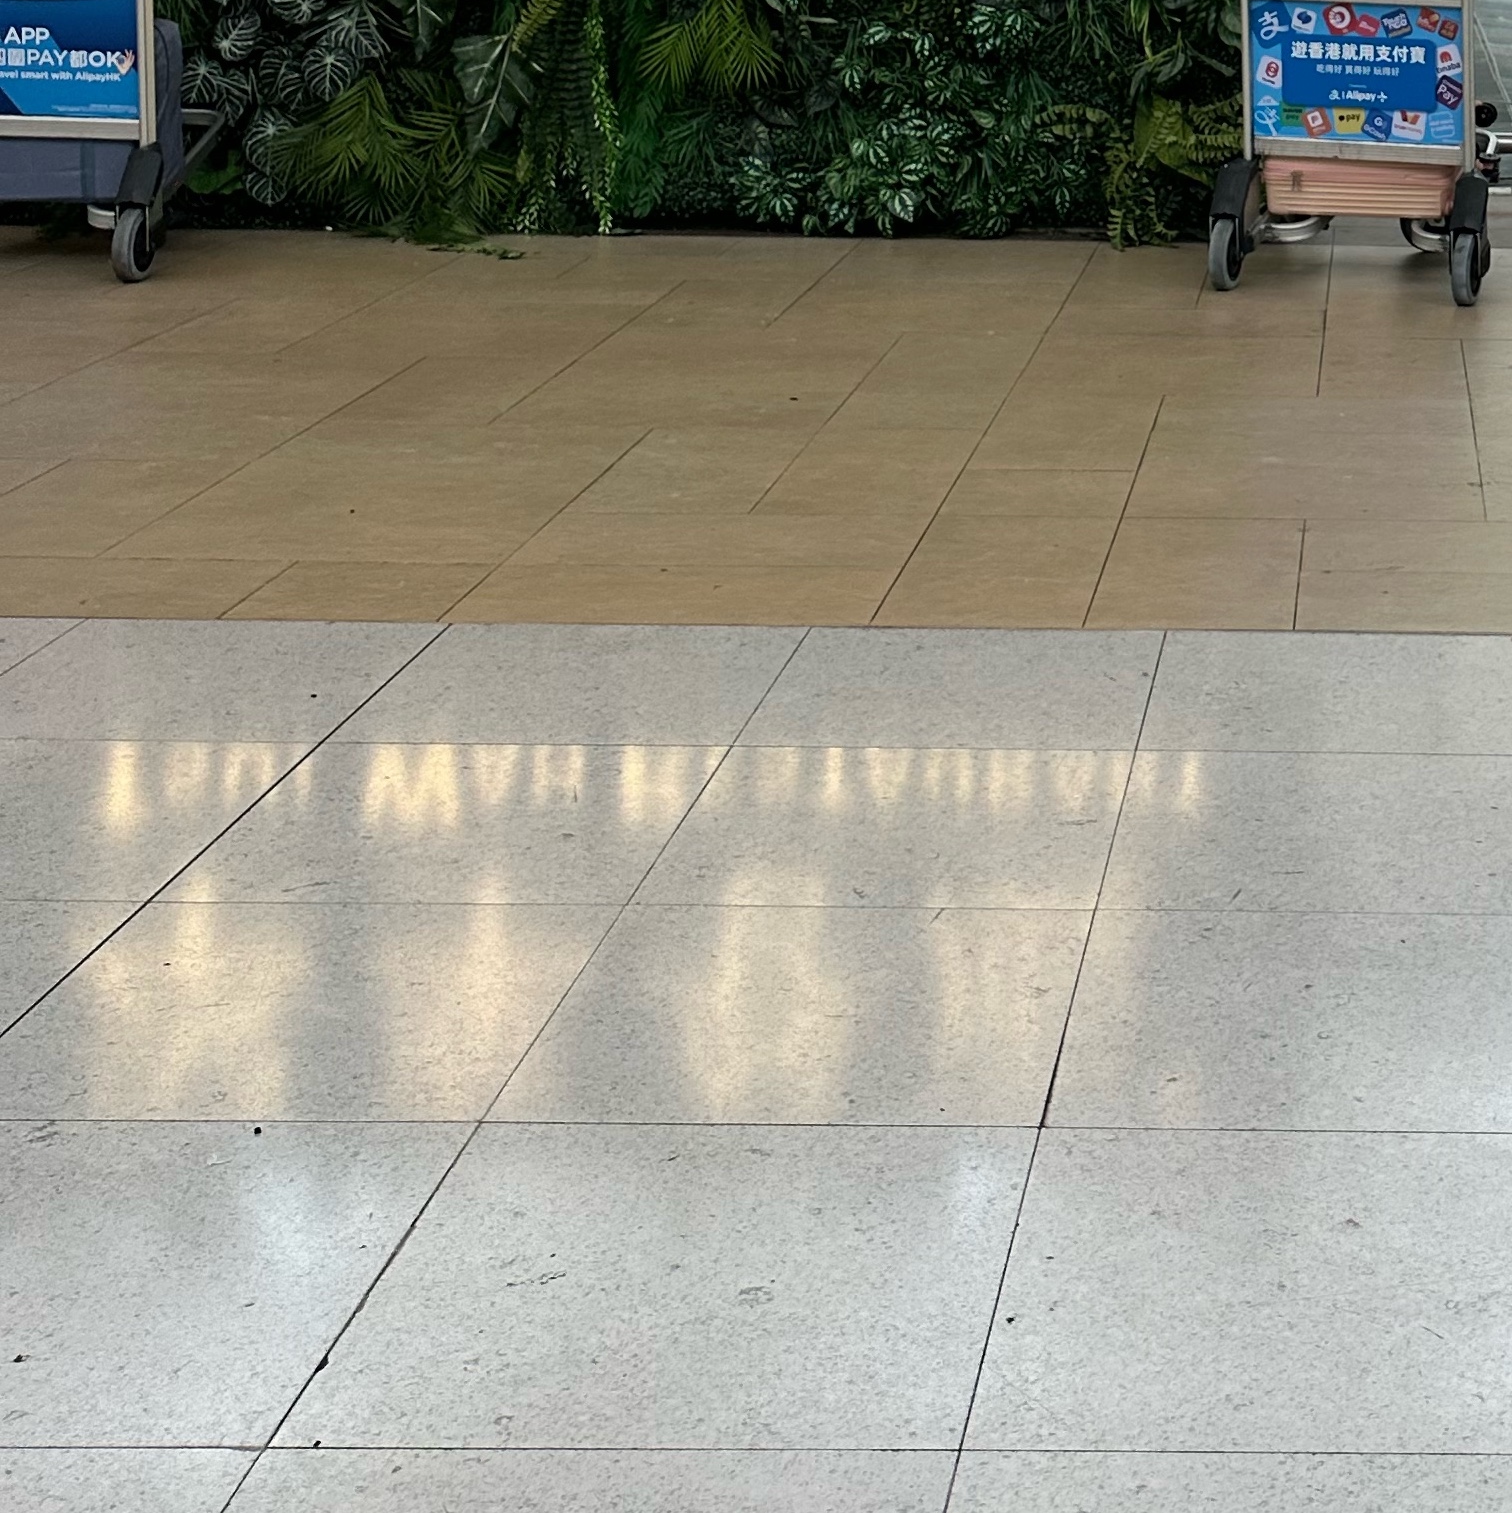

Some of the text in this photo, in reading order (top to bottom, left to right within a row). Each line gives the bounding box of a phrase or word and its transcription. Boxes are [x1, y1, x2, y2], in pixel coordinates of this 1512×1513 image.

[4, 26, 51, 45] APP
[1291, 40, 1426, 64] 遊香港就用支付寶
[20, 71, 49, 80] smart
[50, 71, 73, 81] with
